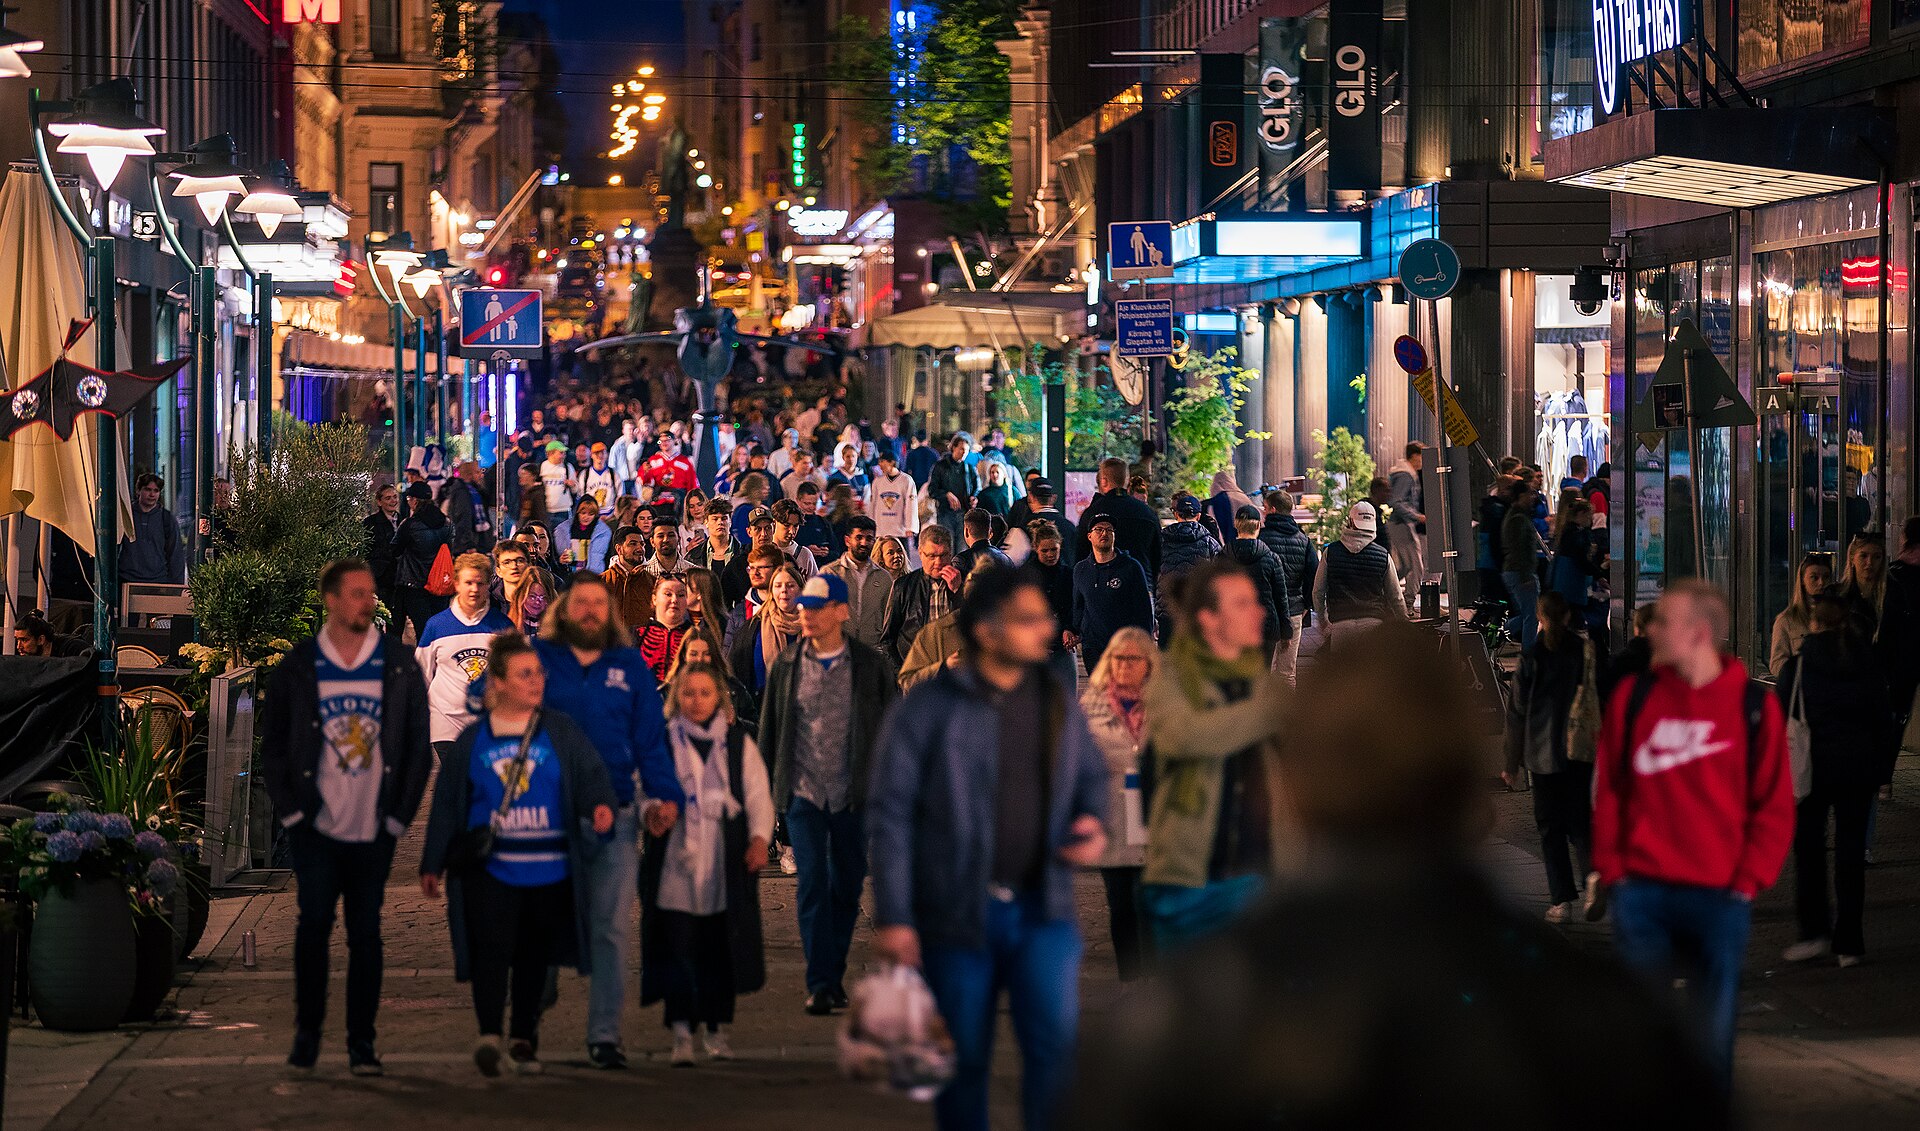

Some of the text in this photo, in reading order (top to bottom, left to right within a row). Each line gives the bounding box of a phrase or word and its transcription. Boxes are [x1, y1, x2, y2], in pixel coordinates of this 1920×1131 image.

[1616, 0, 1644, 64] THE
[1643, 0, 1681, 56] FIRST
[1262, 73, 1292, 143] GLO
[1335, 45, 1366, 117] GLO
[1369, 66, 1377, 97] HOTEL
[1766, 394, 1780, 409] A
